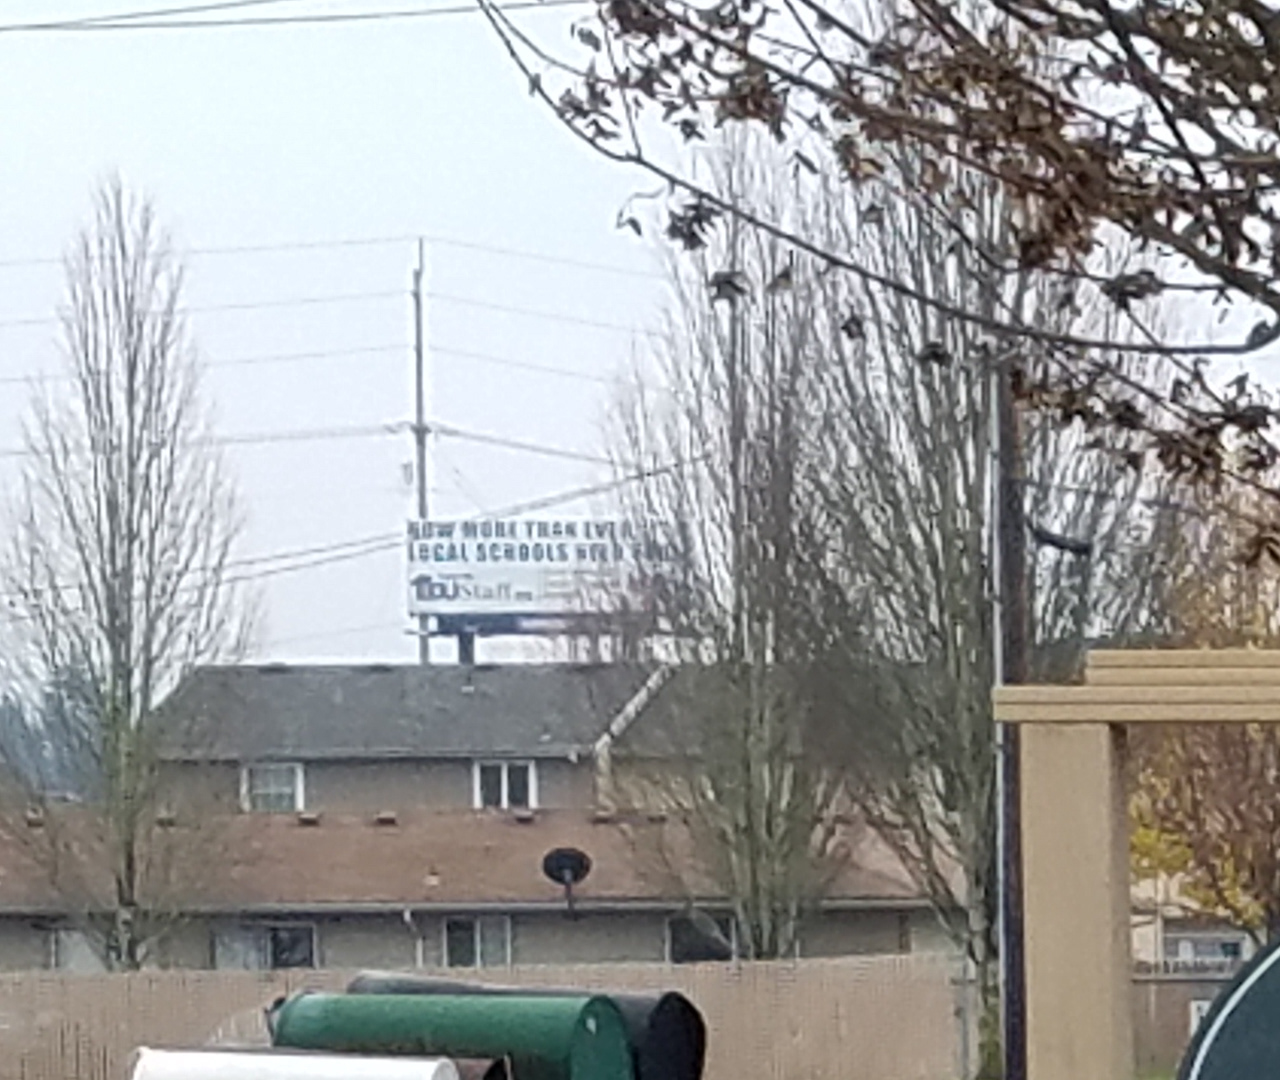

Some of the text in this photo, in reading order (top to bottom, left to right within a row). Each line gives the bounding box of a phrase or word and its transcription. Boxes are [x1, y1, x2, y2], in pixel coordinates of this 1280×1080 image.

[407, 520, 456, 539] NOW
[462, 520, 517, 539] MORE
[525, 520, 577, 538] THAN
[409, 541, 469, 562] LOCAL
[476, 541, 569, 562] SCHOOLS
